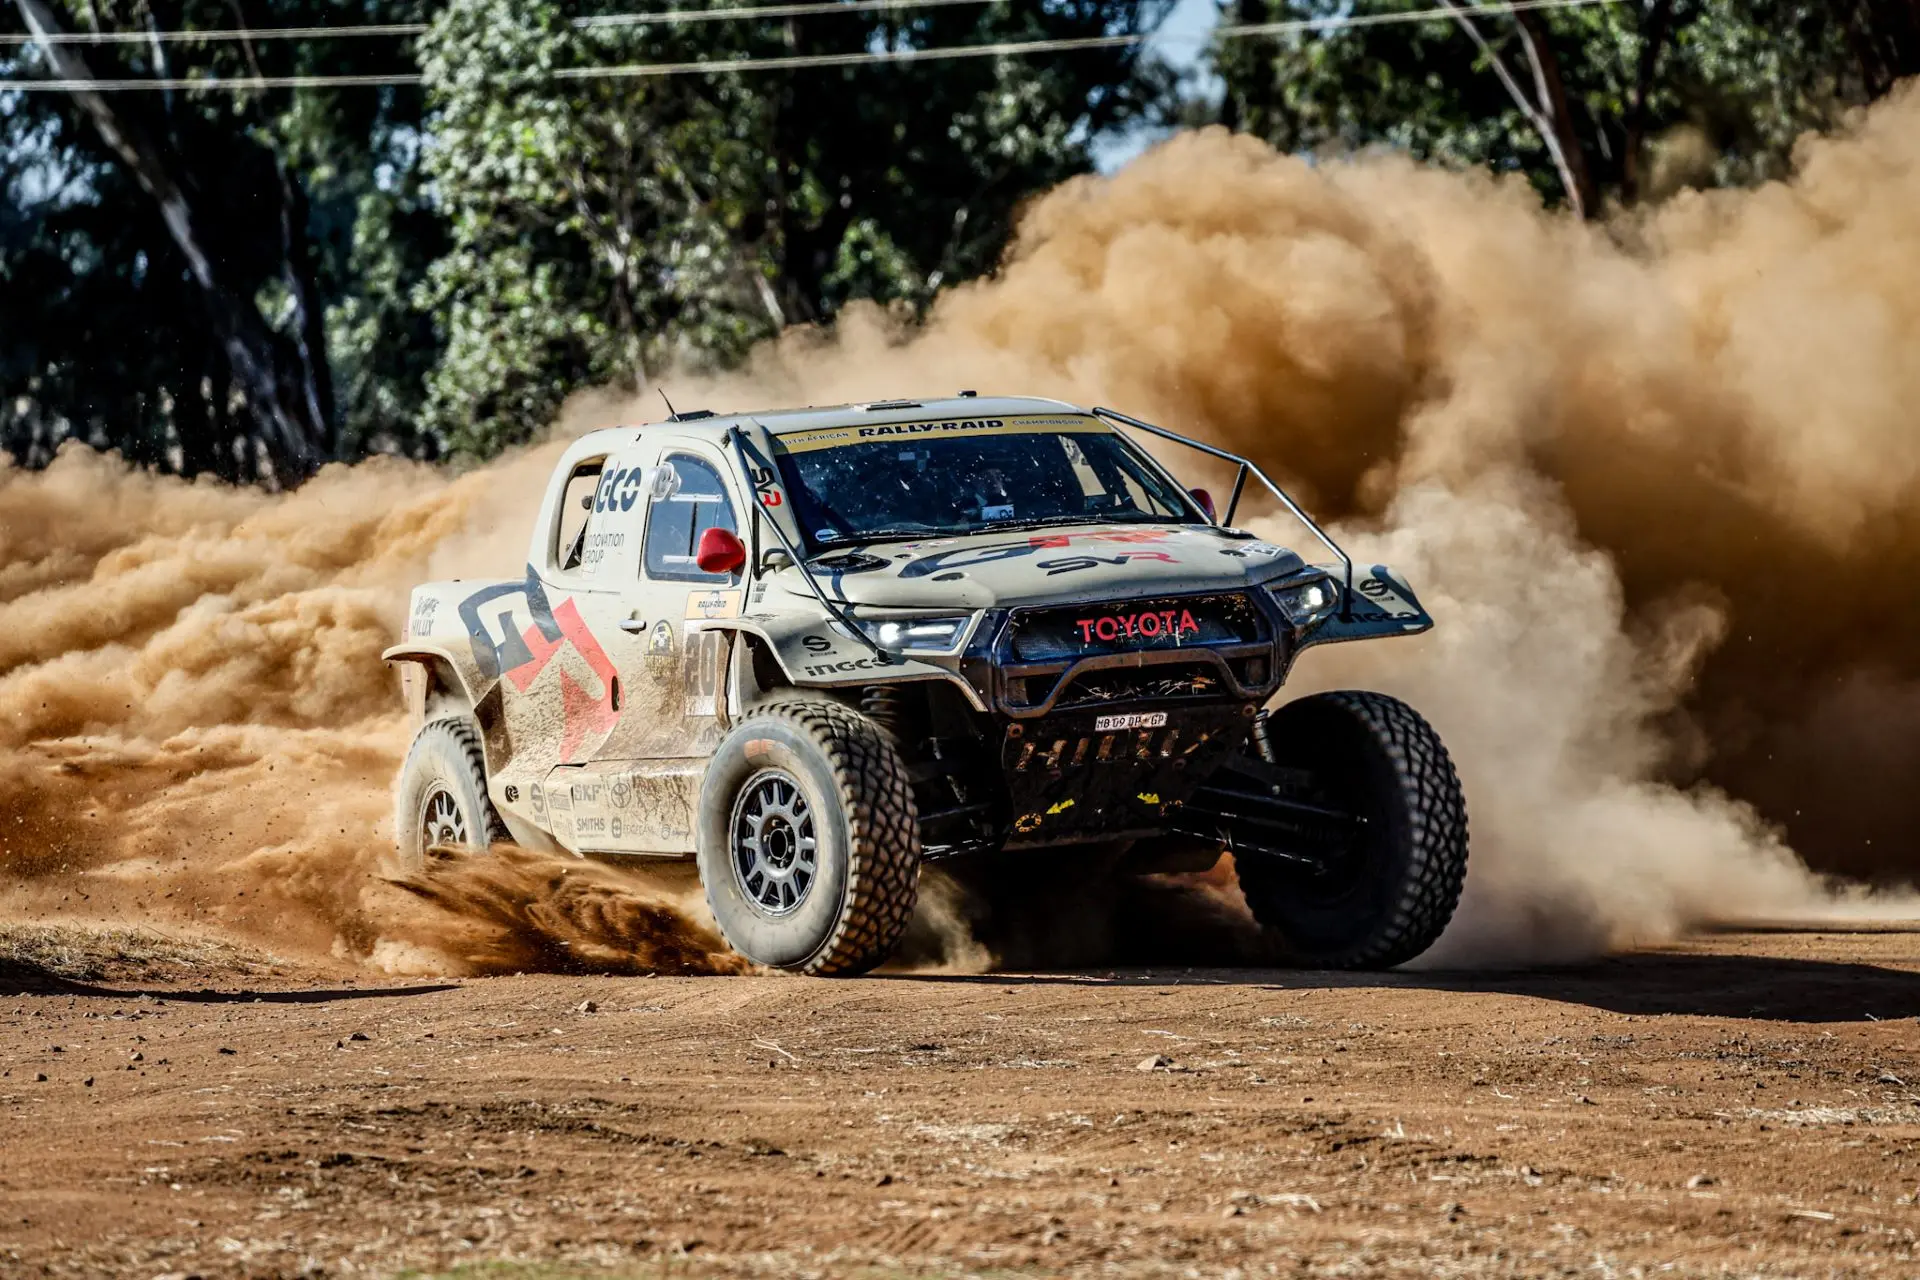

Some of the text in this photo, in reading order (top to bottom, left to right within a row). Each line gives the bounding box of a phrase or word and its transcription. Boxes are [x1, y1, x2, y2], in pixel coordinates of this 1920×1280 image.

[807, 432, 849, 442] AFRICAN
[858, 418, 1004, 437] RALLY-RAID
[1076, 609, 1200, 643] TOYOTA
[1151, 713, 1164, 726] GP
[575, 784, 601, 801] SKF
[576, 817, 606, 832] SMITHS
